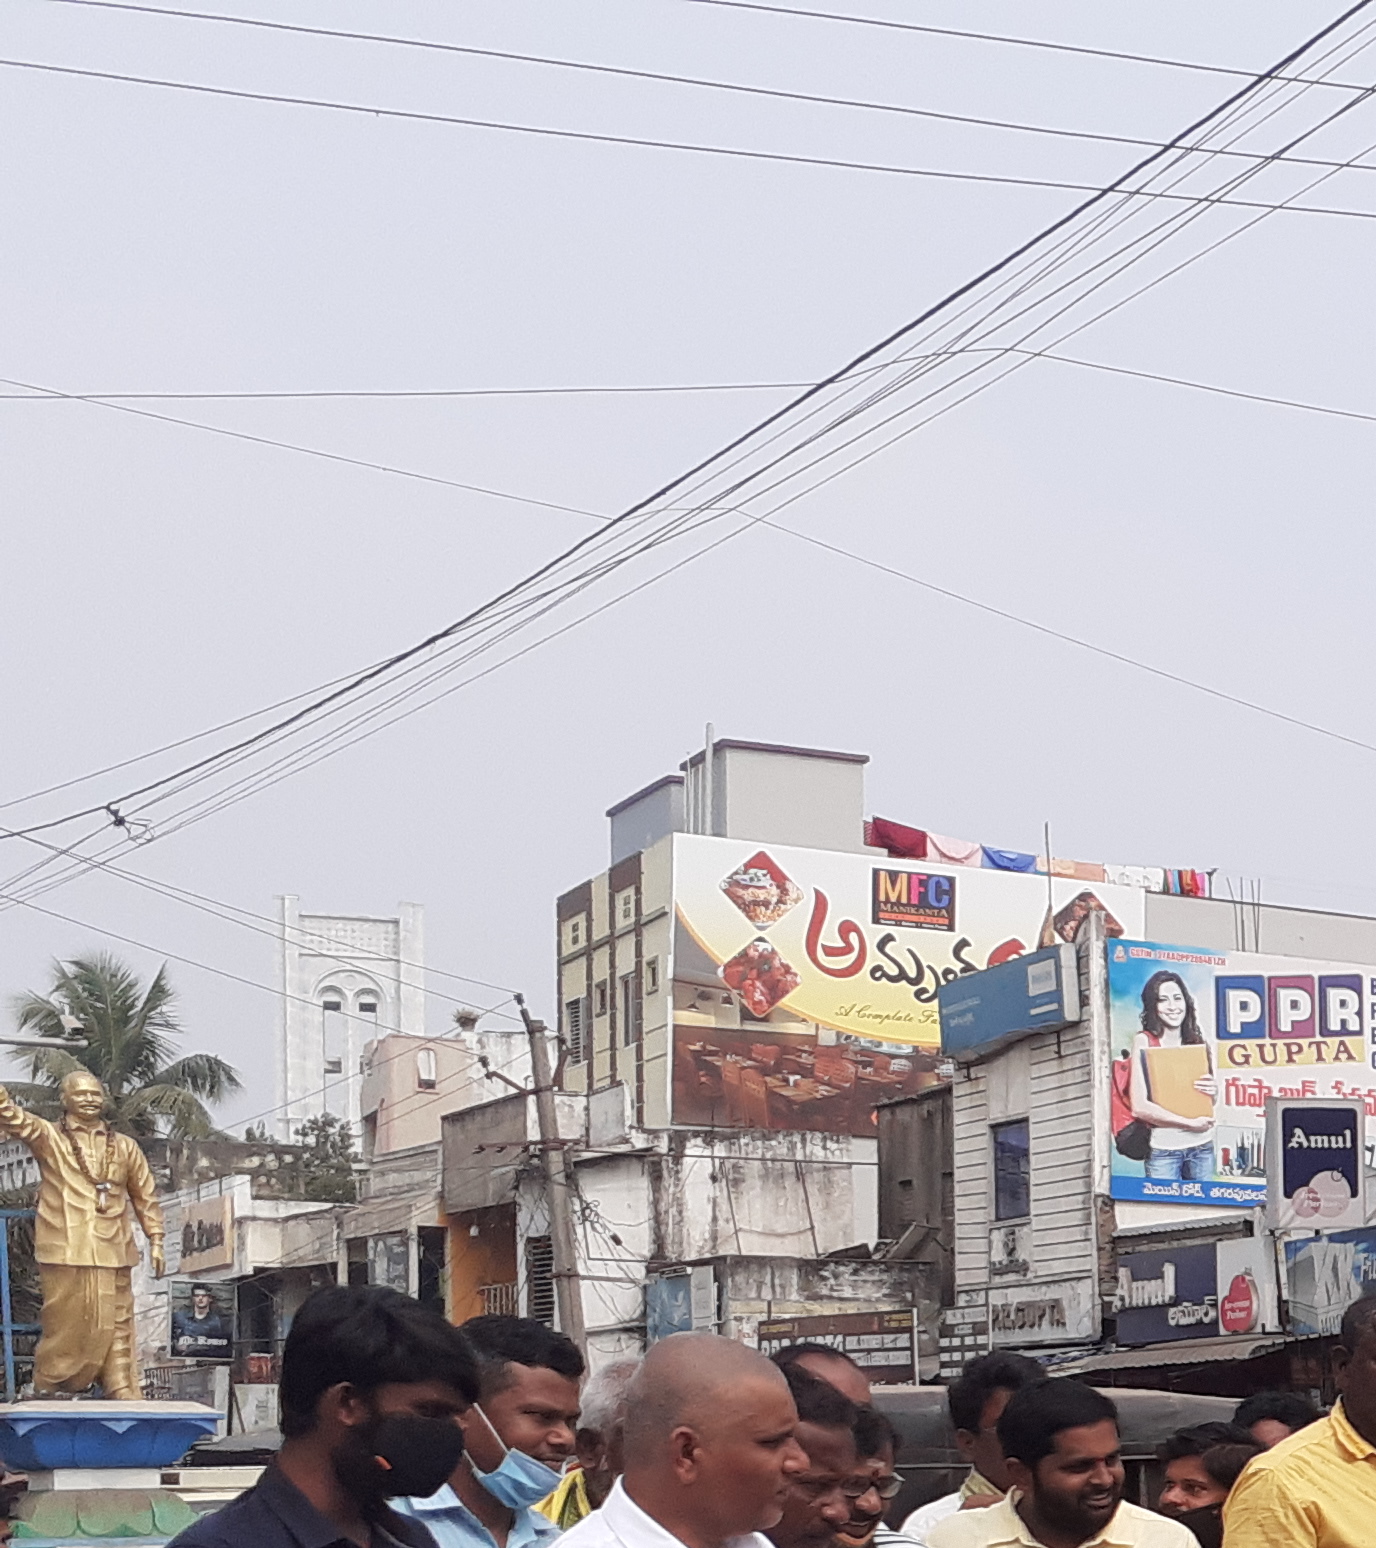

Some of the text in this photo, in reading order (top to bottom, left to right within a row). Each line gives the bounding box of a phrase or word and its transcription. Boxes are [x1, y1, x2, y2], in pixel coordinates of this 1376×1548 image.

[878, 870, 951, 908] MFC
[1223, 984, 1362, 1035] PPR
[1228, 1038, 1357, 1066] GUPTA
[1287, 1127, 1353, 1149] Amul
[1112, 1262, 1177, 1313] Amul
